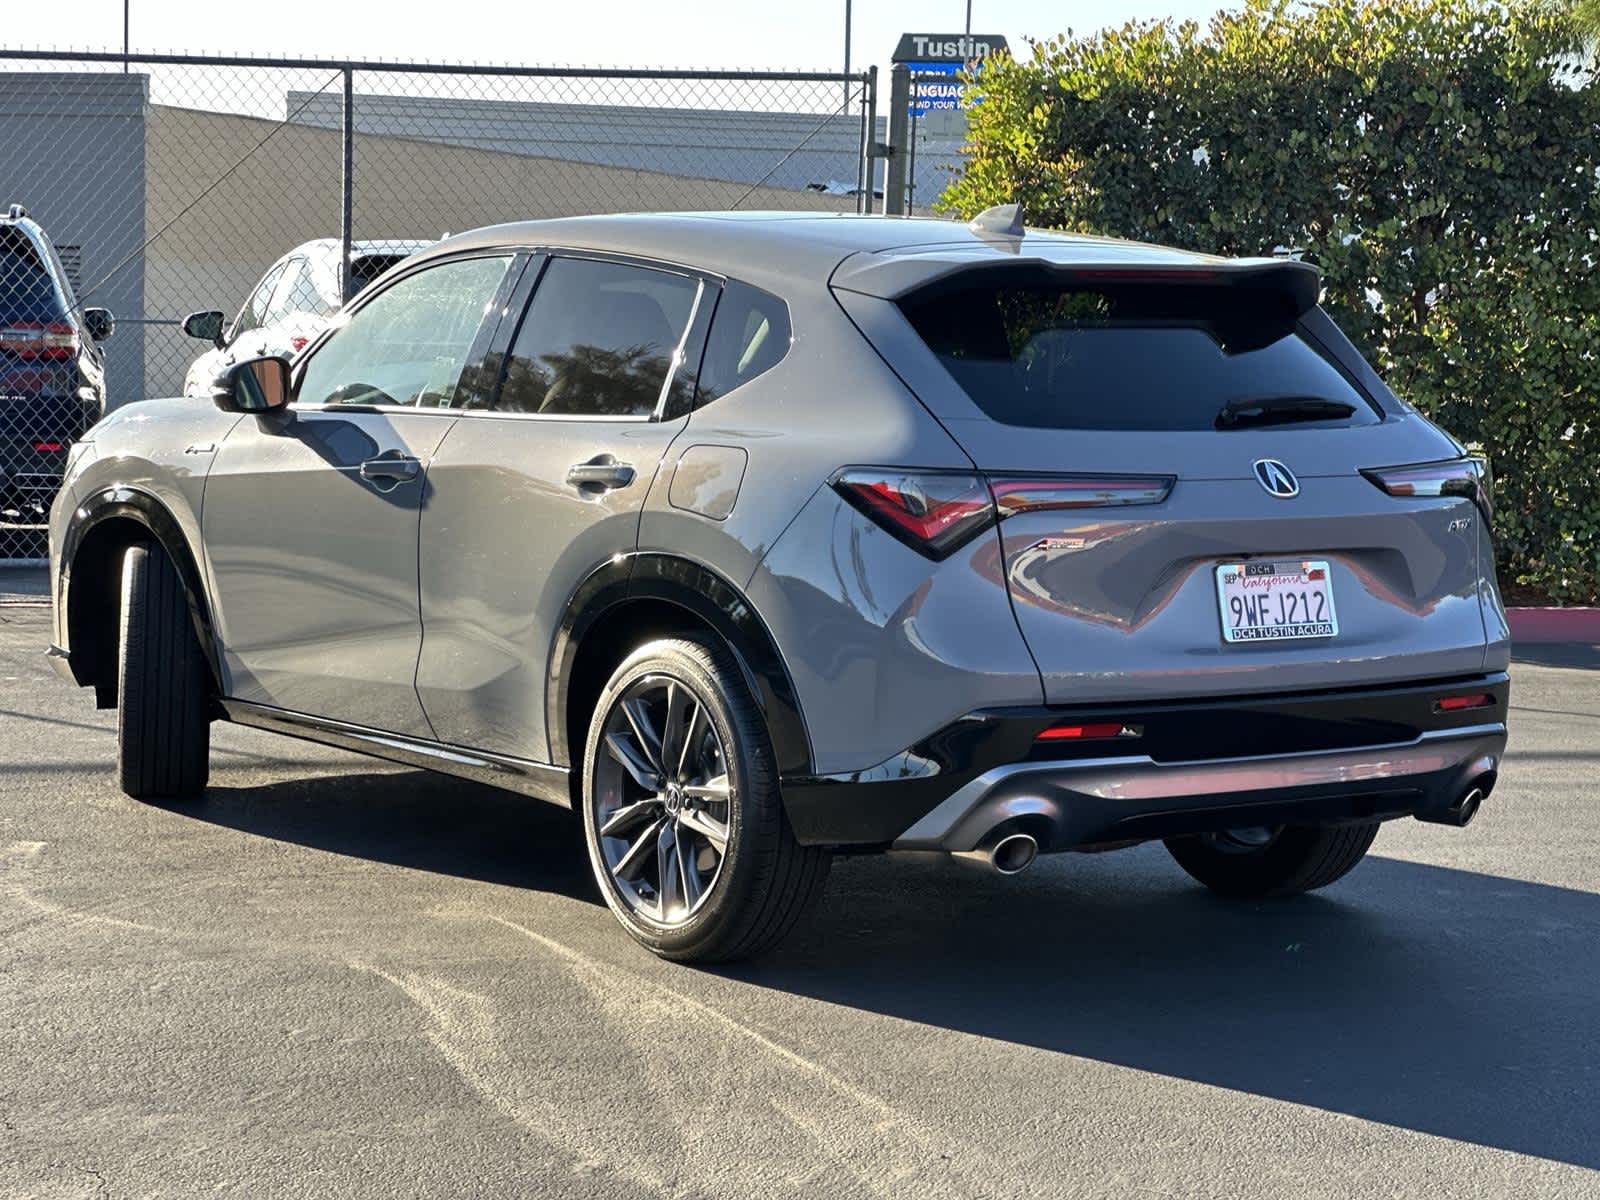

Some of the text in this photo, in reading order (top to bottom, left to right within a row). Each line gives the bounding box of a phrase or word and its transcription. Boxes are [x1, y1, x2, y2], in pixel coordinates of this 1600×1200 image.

[912, 36, 990, 57] Tustin
[1224, 574, 1236, 584] SEP
[1242, 575, 1306, 592] California
[1230, 591, 1328, 627] 9WFJ212
[1233, 625, 1332, 639] DCH TUSTIN ACURA
